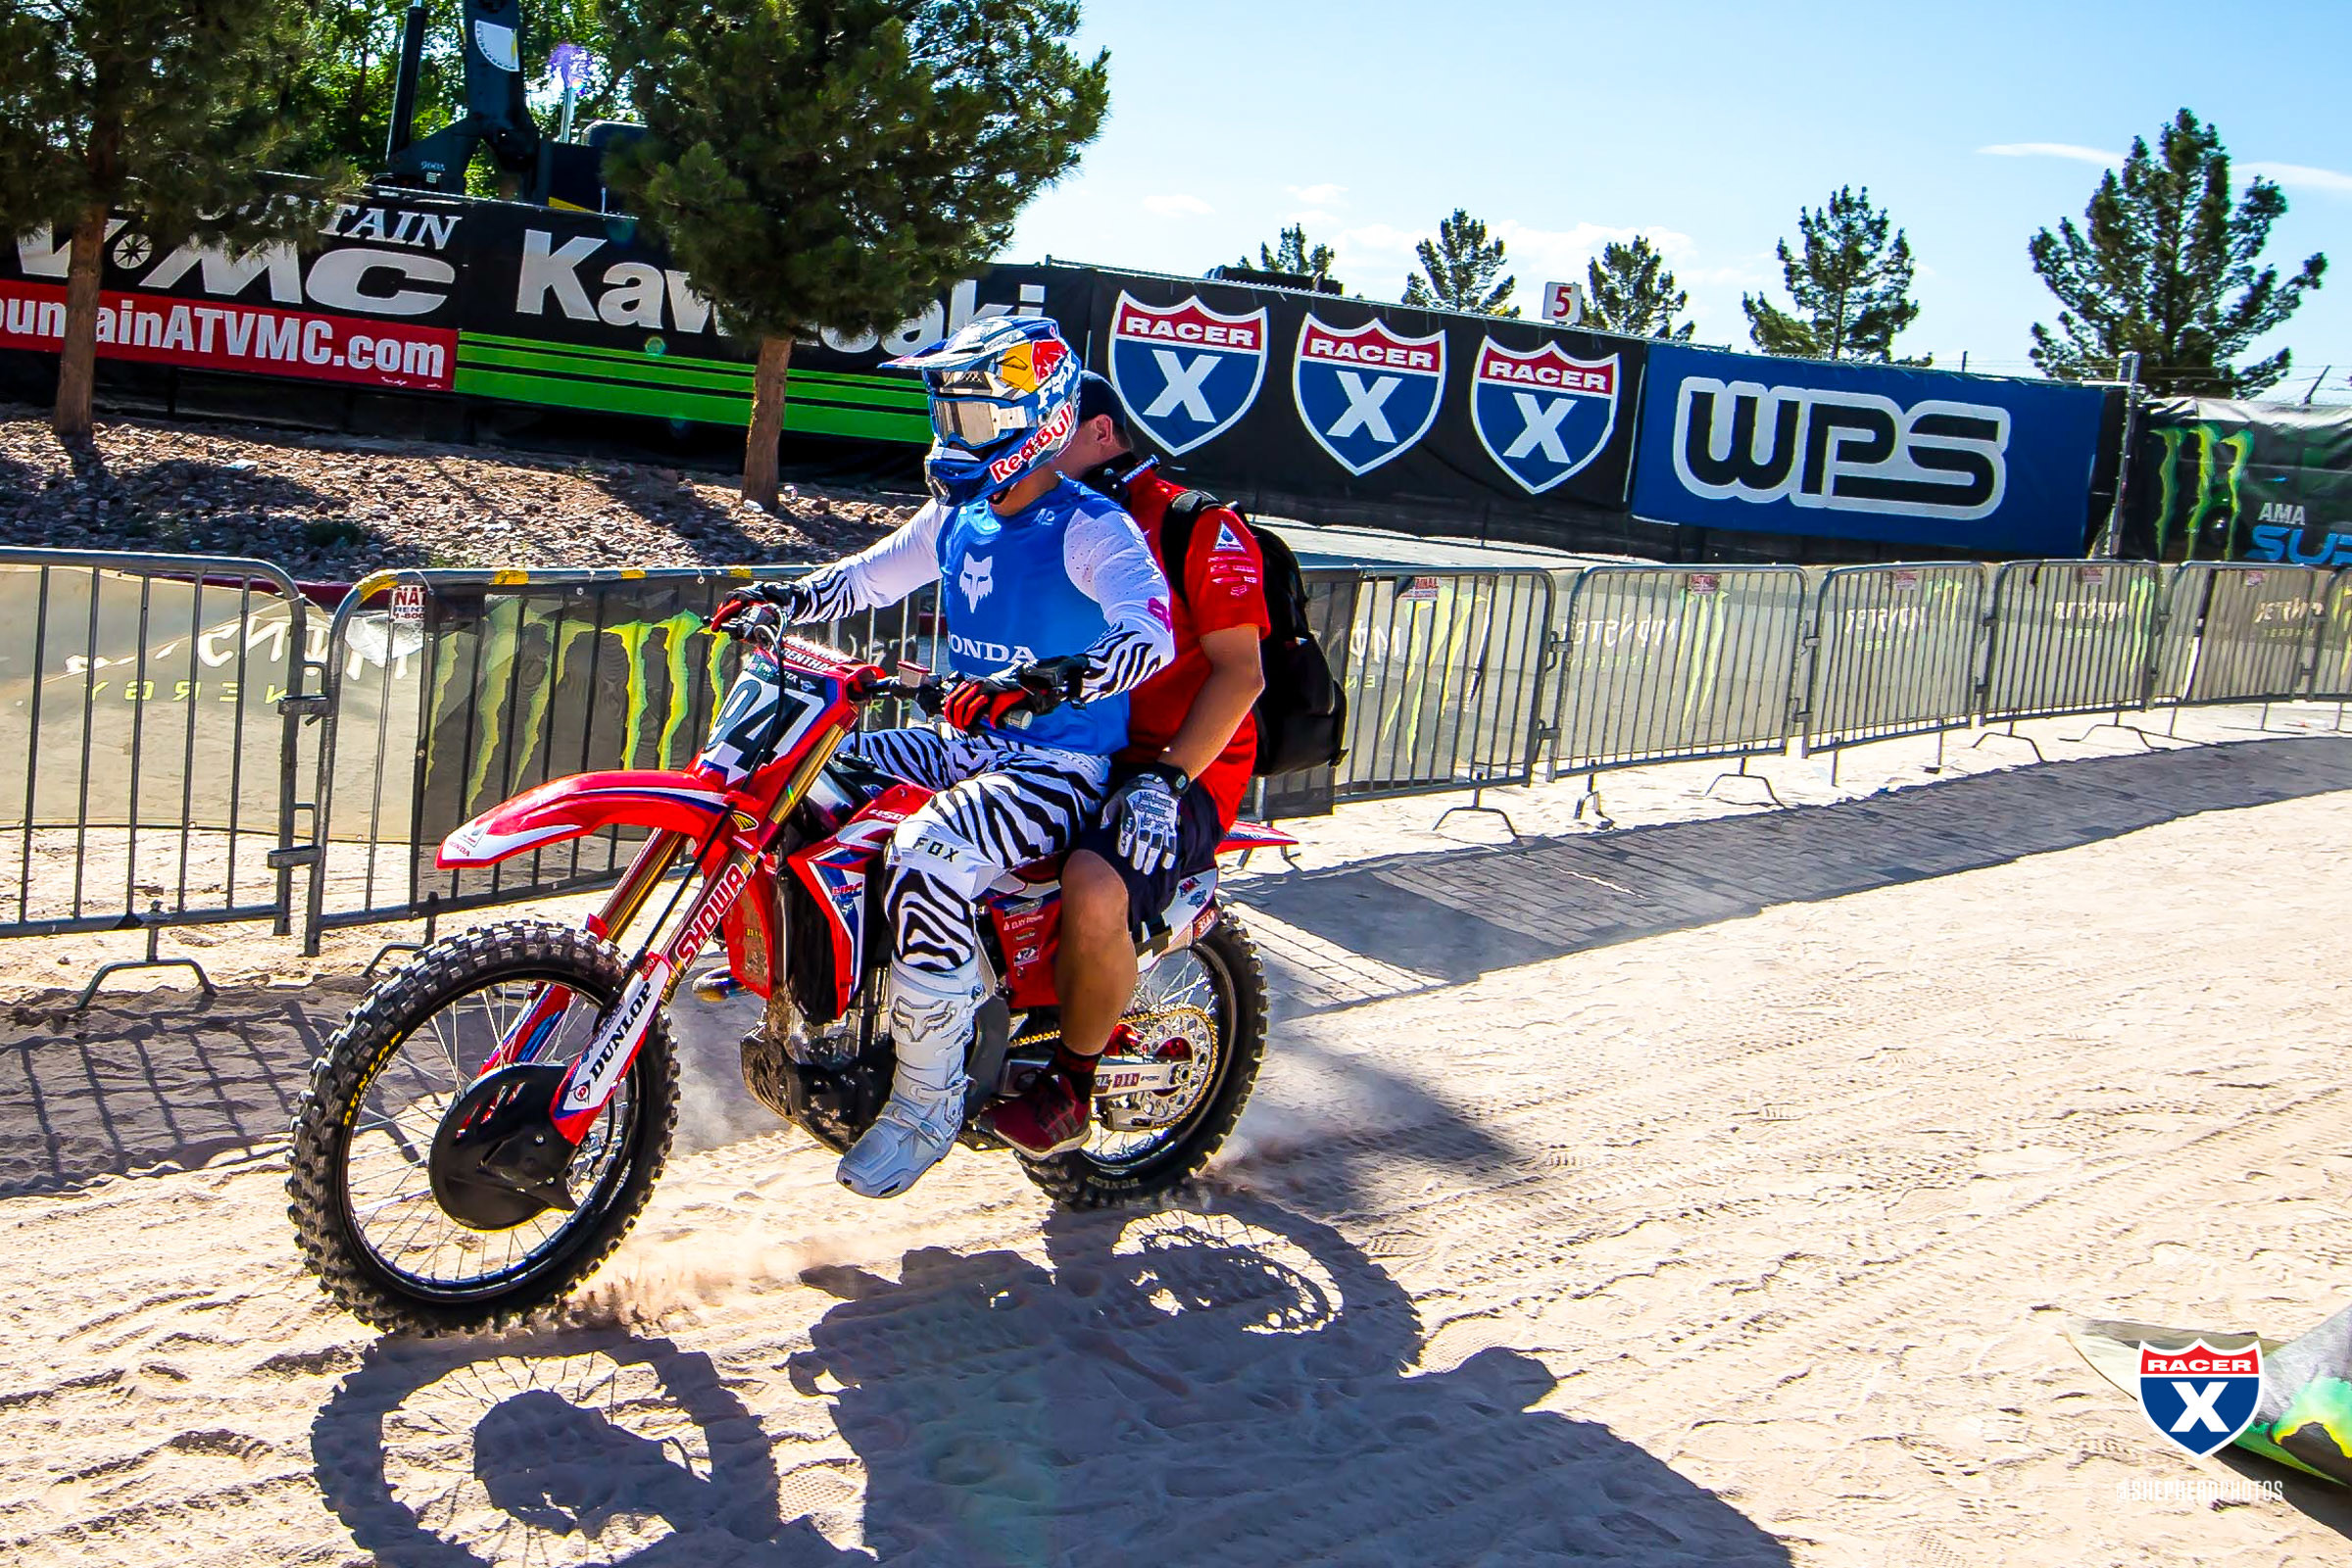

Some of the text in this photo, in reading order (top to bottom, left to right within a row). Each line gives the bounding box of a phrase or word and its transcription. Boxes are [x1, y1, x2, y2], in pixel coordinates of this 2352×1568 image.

[516, 229, 1046, 357] Kawak
[1552, 285, 1573, 318] 5
[0, 297, 444, 378] unainATVMC.com
[1126, 315, 1254, 347] RACER
[1310, 337, 1434, 368] RACER
[1143, 349, 1222, 423] X
[1326, 369, 1401, 443] X
[1488, 361, 1607, 391] RACER
[1502, 392, 1578, 464] X
[1674, 376, 2011, 520] WPS
[2258, 501, 2306, 526] AMA
[947, 632, 1038, 664] ONDA
[912, 837, 960, 862] FOX
[675, 862, 747, 970] SHOWA
[589, 981, 652, 1082] DUNLOP
